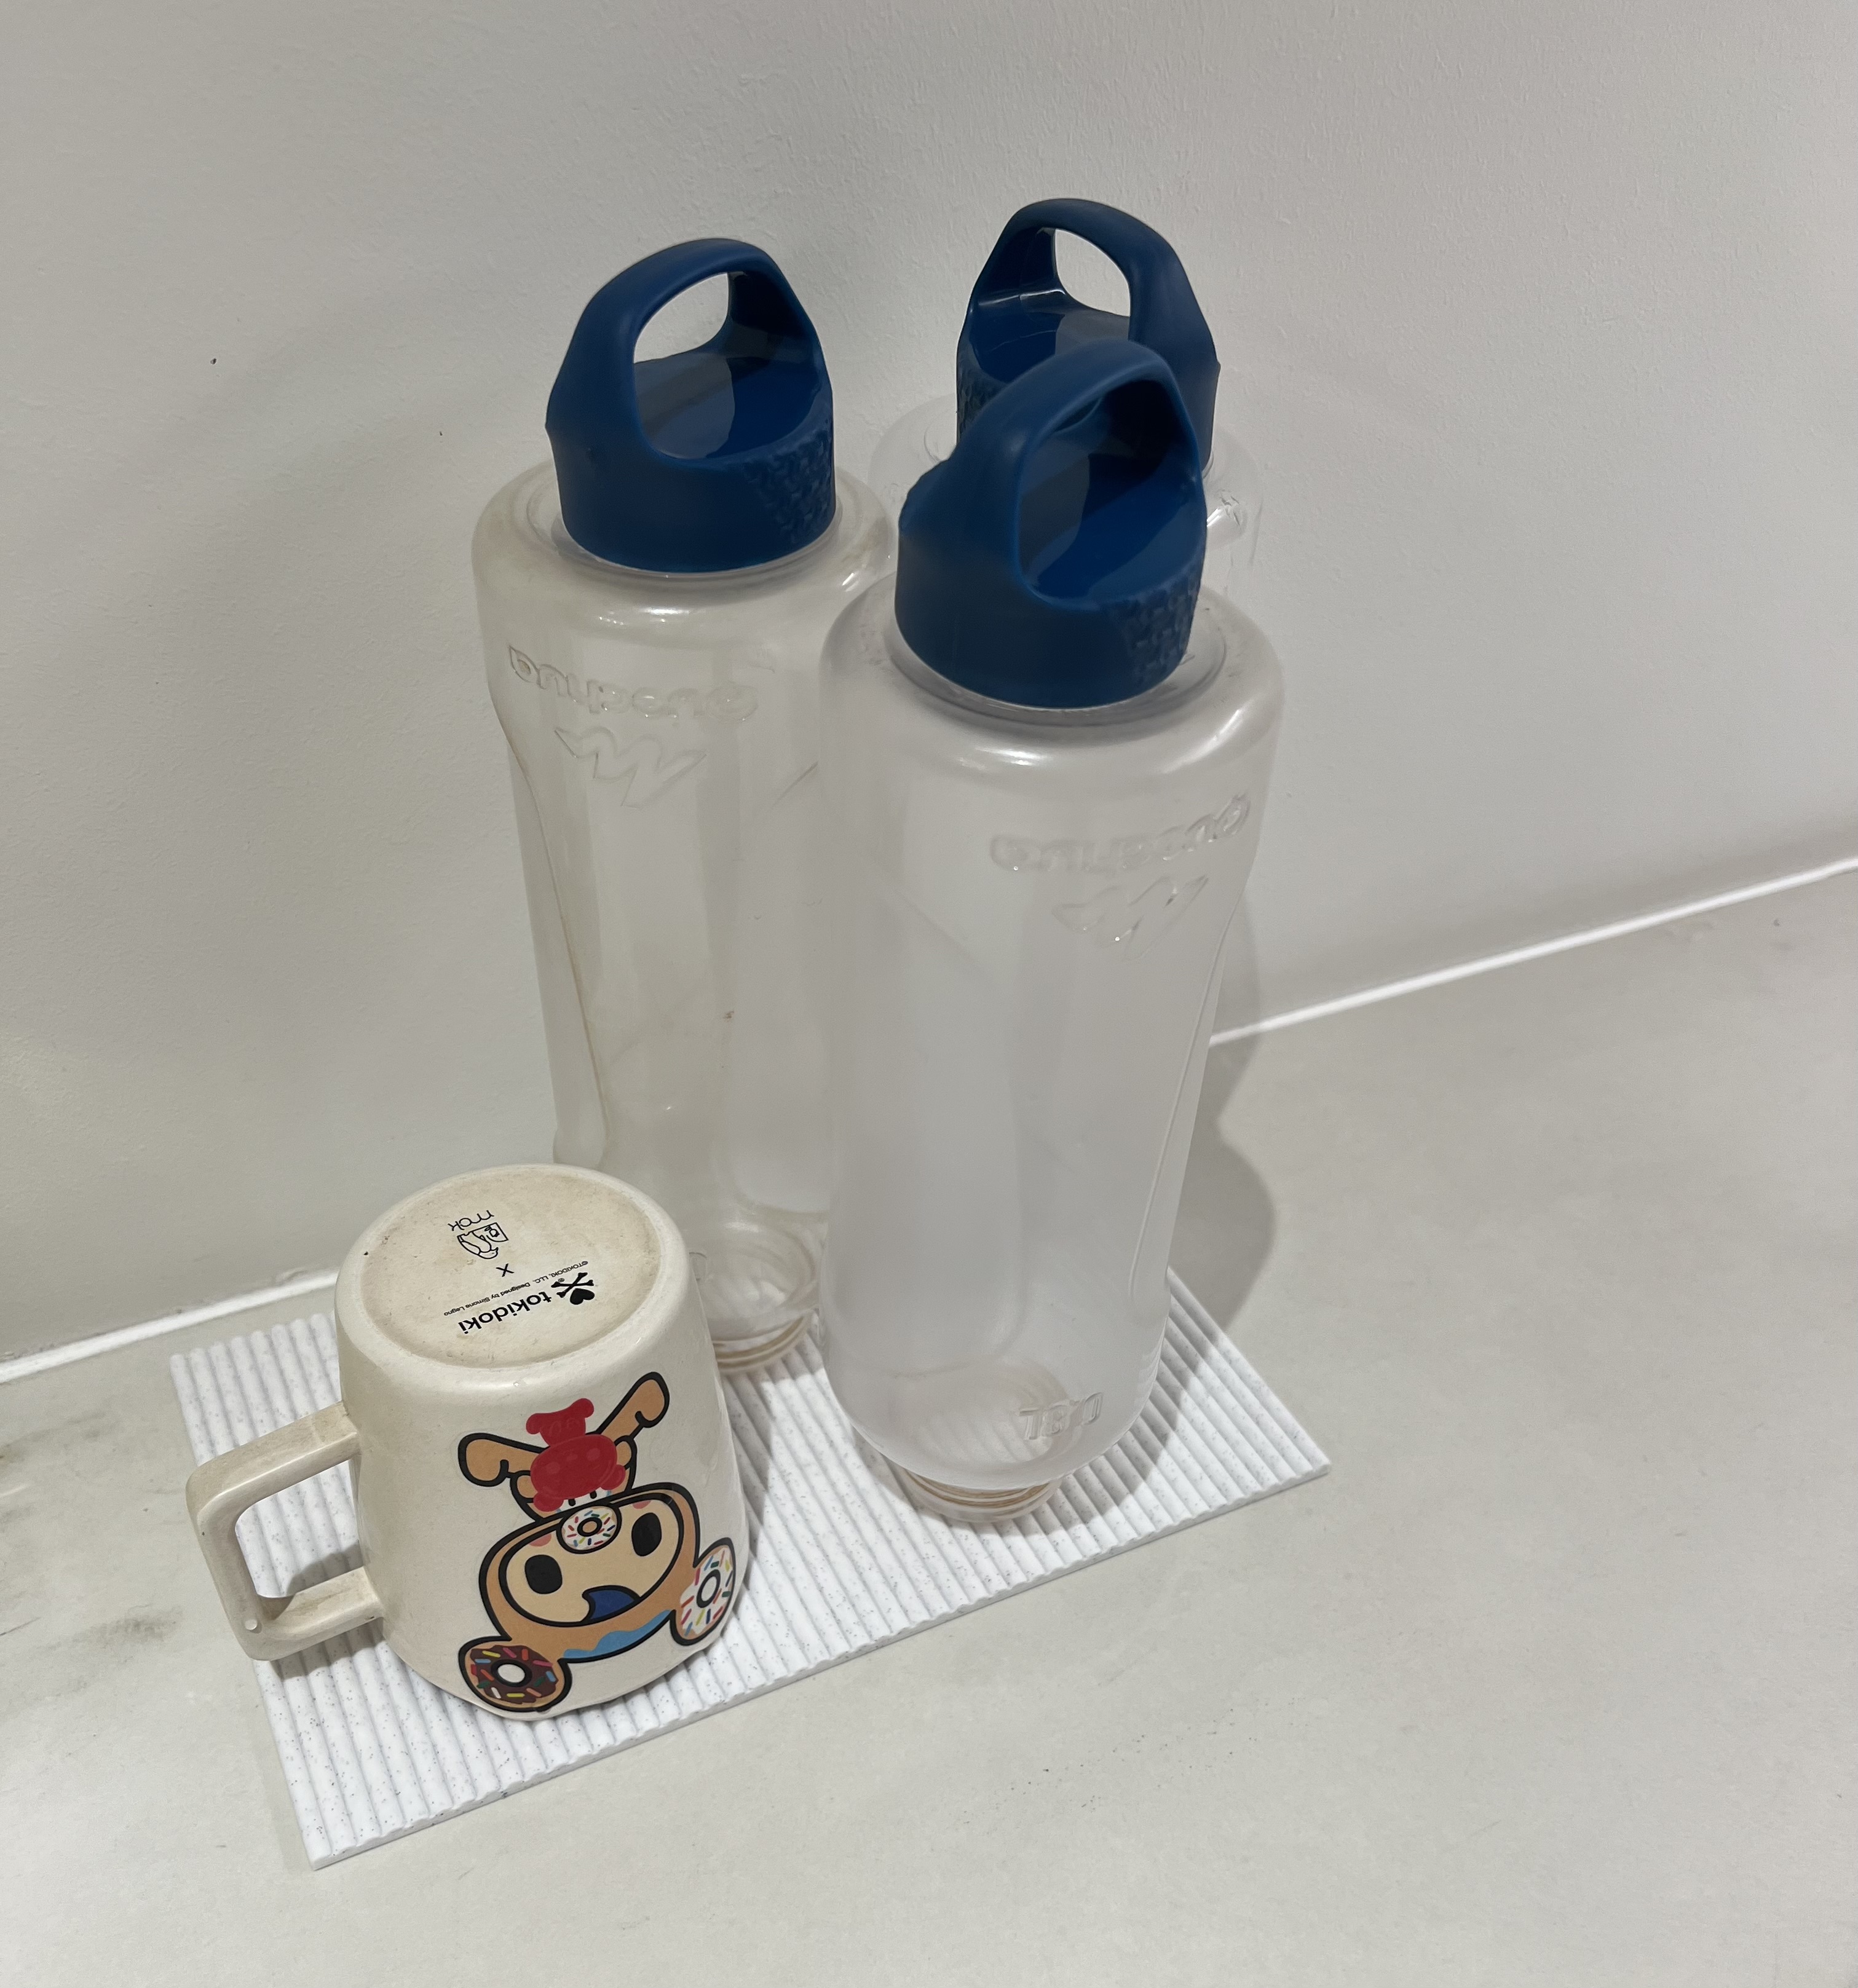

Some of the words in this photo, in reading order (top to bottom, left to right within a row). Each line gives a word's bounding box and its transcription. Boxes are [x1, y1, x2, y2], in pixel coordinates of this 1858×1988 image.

[447, 1209, 495, 1232] mok
[532, 1275, 548, 1284] LLC.
[500, 1282, 531, 1296] Designed
[465, 1296, 491, 1309] Simone
[443, 1306, 465, 1316] Legno
[457, 1291, 552, 1335] tokidoki
